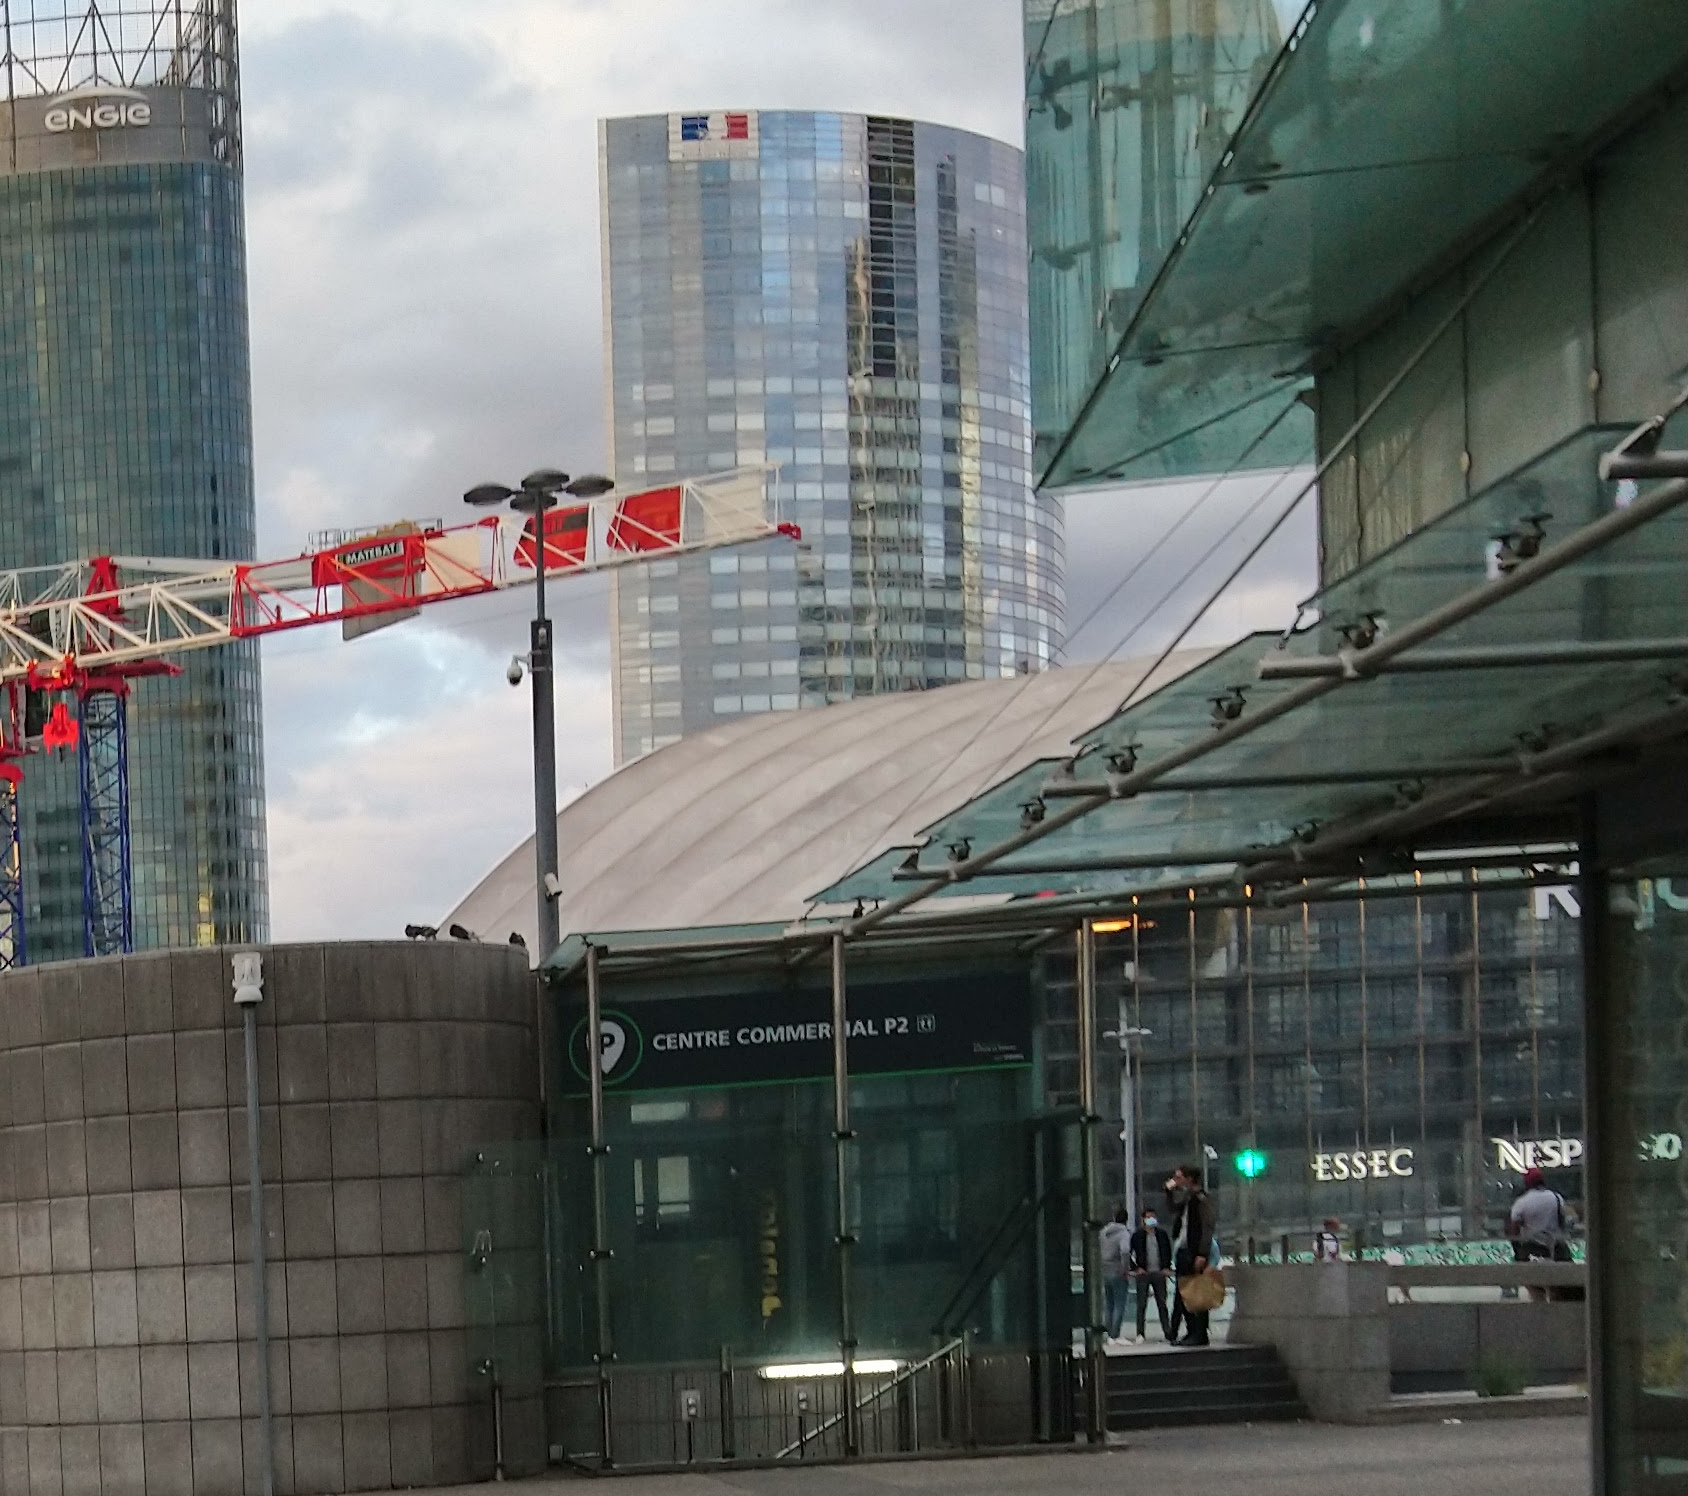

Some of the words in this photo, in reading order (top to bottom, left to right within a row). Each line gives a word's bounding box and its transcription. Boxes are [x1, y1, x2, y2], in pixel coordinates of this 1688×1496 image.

[653, 1030, 730, 1051] CENTRE
[737, 1018, 879, 1045] COMMERIAL
[884, 1016, 910, 1035] P2
[1311, 1149, 1413, 1182] ESSEC
